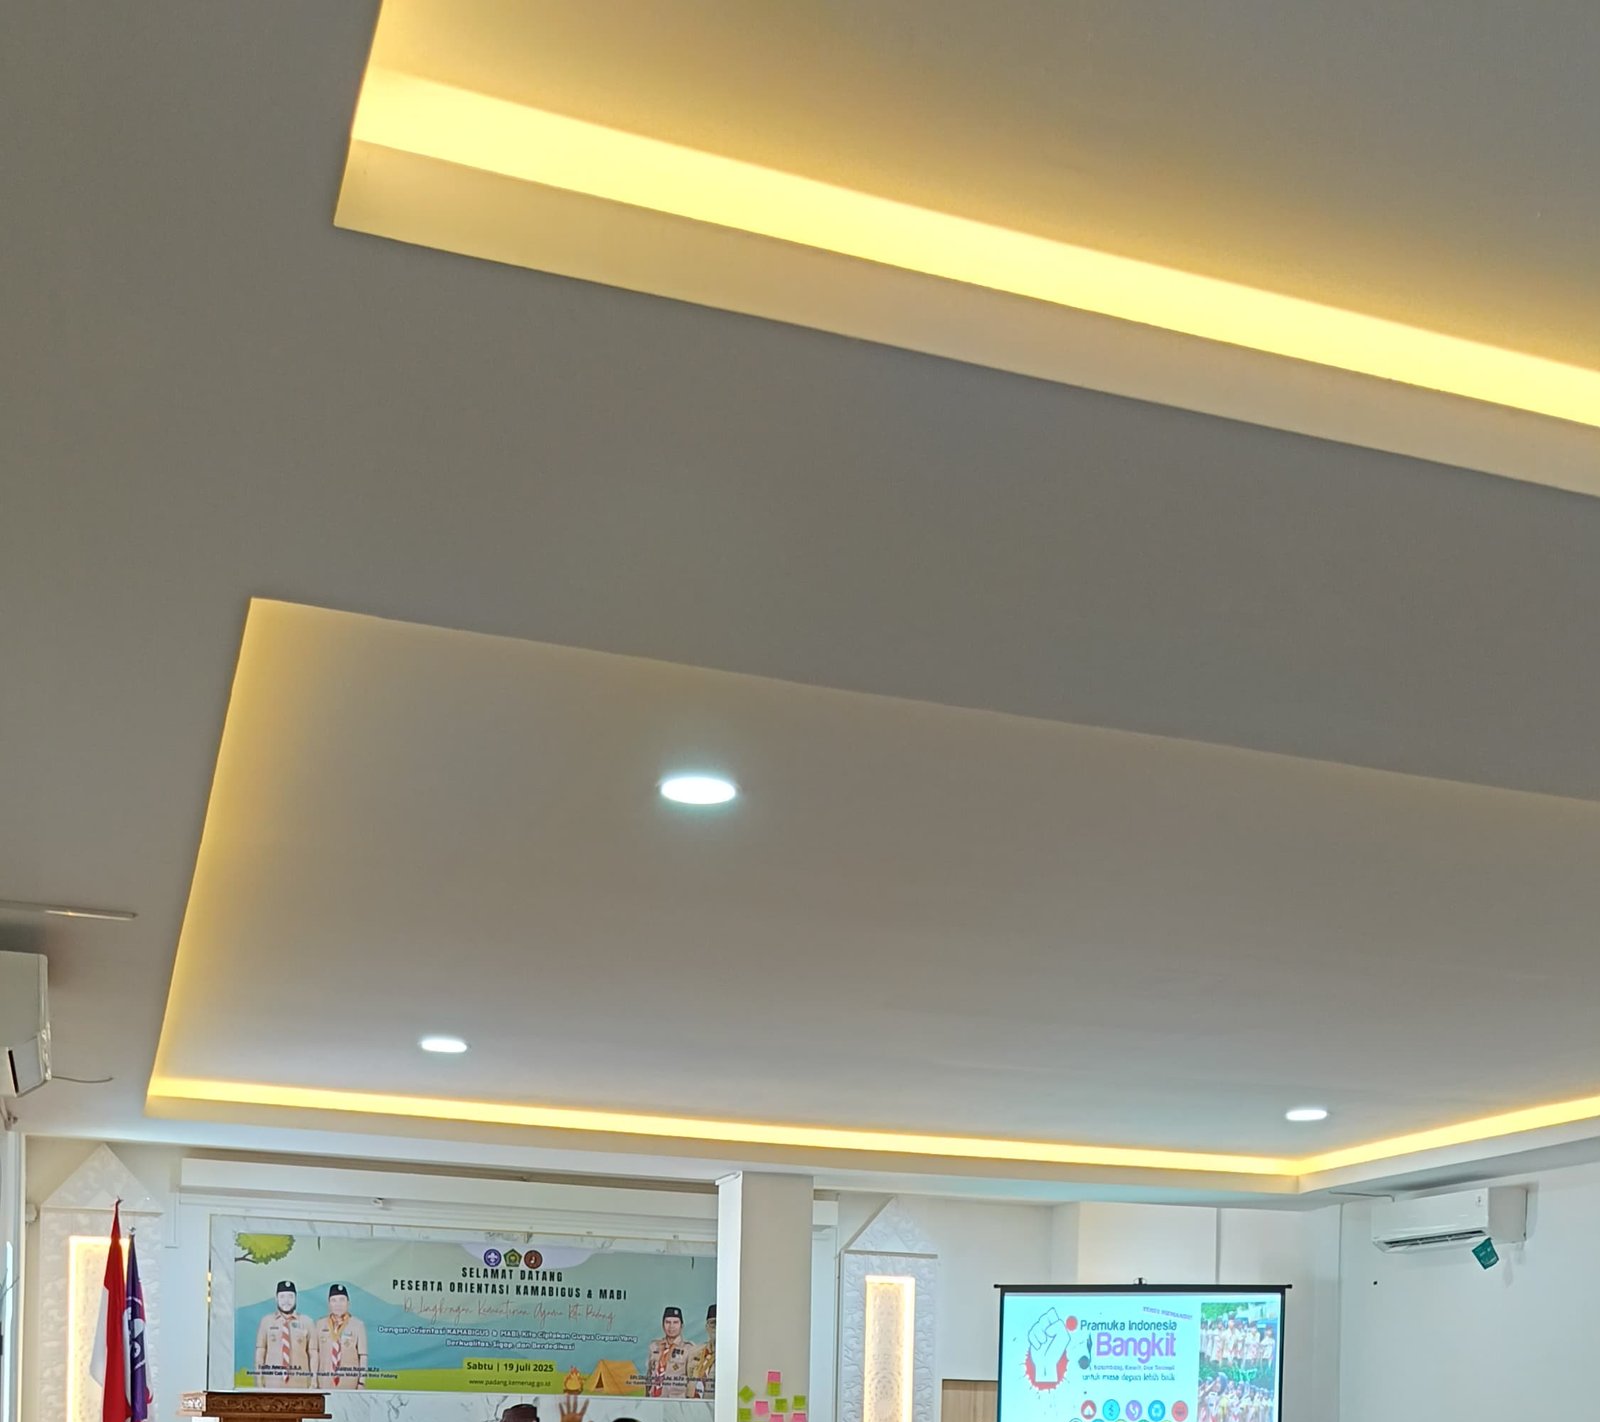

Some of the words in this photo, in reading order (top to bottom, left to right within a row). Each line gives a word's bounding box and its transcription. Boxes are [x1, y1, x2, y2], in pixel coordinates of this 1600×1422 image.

[461, 1266, 514, 1280] SELAMAT
[519, 1269, 563, 1282] DATANG
[392, 1279, 443, 1292] PESERTA
[449, 1281, 509, 1295] ORIENTASI
[515, 1284, 581, 1298] KAMABIGUS
[586, 1289, 593, 1299] &
[599, 1288, 627, 1300] MABI
[1080, 1319, 1126, 1331] Pramuka
[1128, 1319, 1178, 1331] Indonesia
[378, 1326, 409, 1336] Dengan
[410, 1326, 446, 1336] Orientasi
[446, 1328, 490, 1337] KAMABIGUS
[538, 1331, 571, 1341] Ciptakan
[571, 1333, 596, 1341] Gugus
[595, 1334, 619, 1343] Depan
[620, 1335, 639, 1343] Yang
[516, 1342, 530, 1350] dan
[531, 1342, 576, 1351] Berdedikasi
[1095, 1331, 1177, 1364] Bangkit
[466, 1361, 494, 1371] Sabtu
[503, 1362, 514, 1372] 19
[514, 1362, 531, 1373] Juli
[533, 1363, 554, 1373] 2025
[468, 1378, 552, 1388] www.padang.kemenag.go.id
